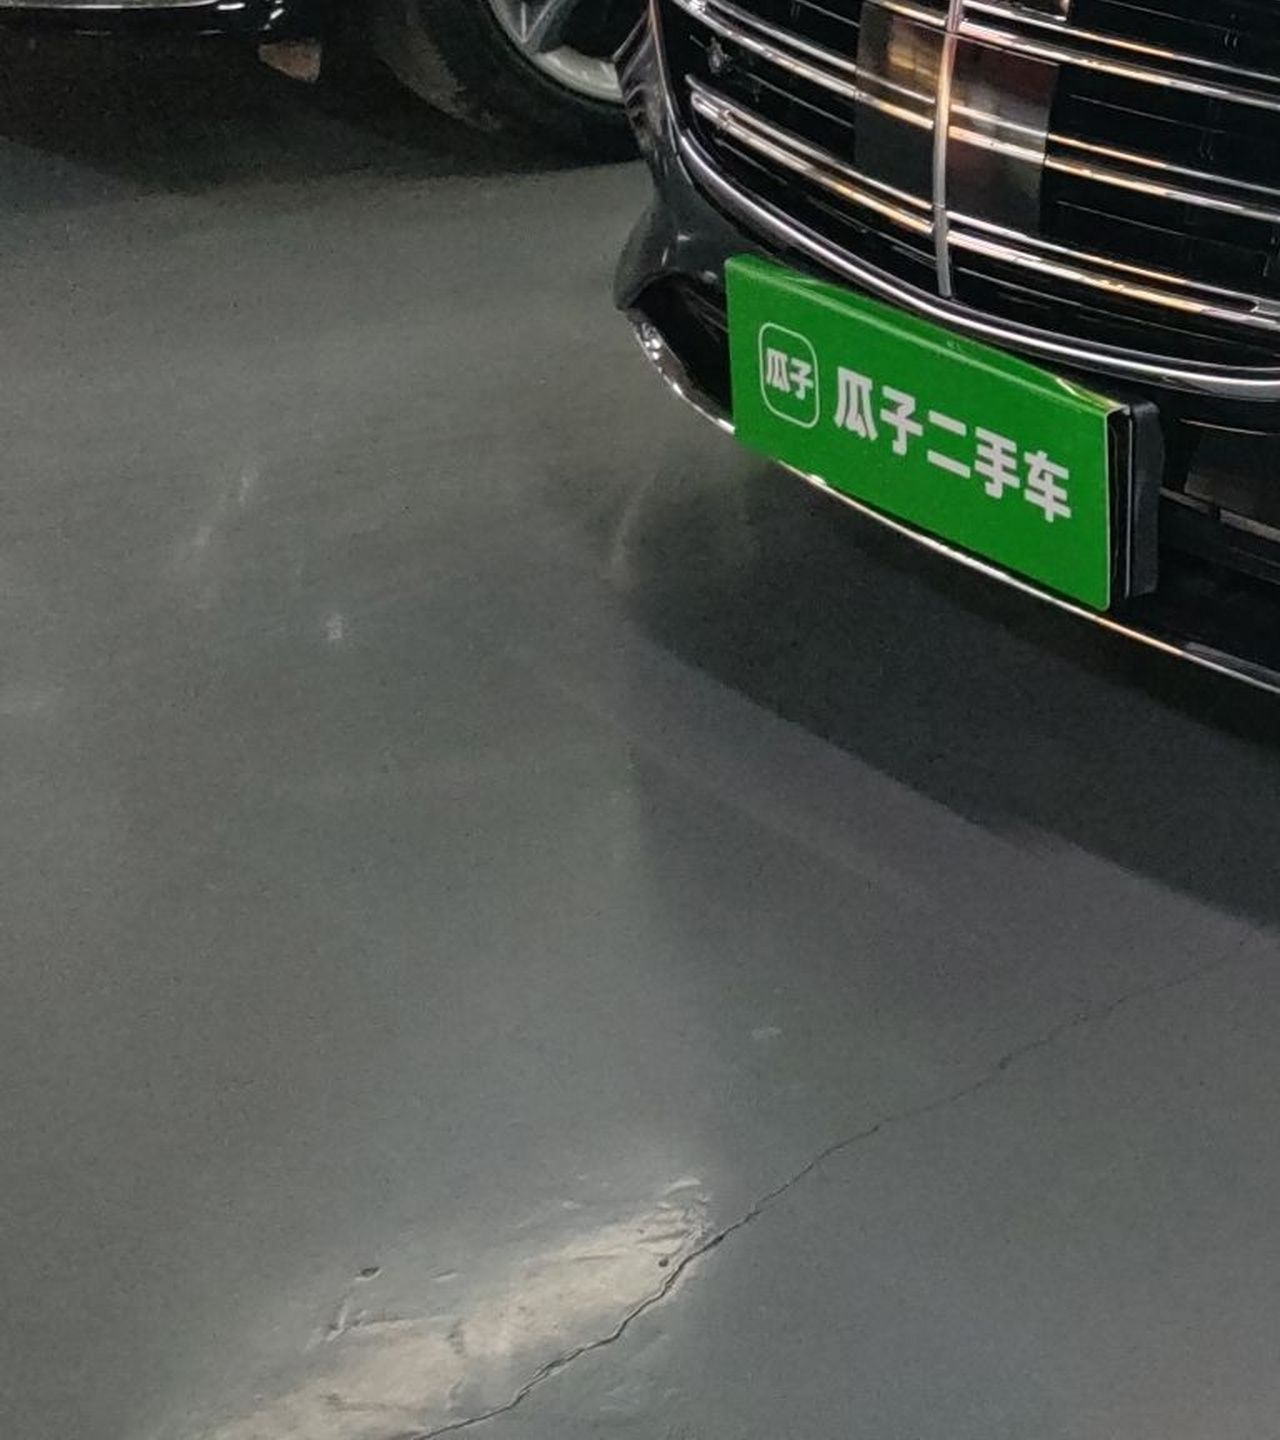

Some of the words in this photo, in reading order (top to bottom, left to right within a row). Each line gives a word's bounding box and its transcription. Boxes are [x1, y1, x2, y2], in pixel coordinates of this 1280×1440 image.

[766, 347, 814, 400] 瓜子
[834, 366, 1072, 523] 瓜子二手车
